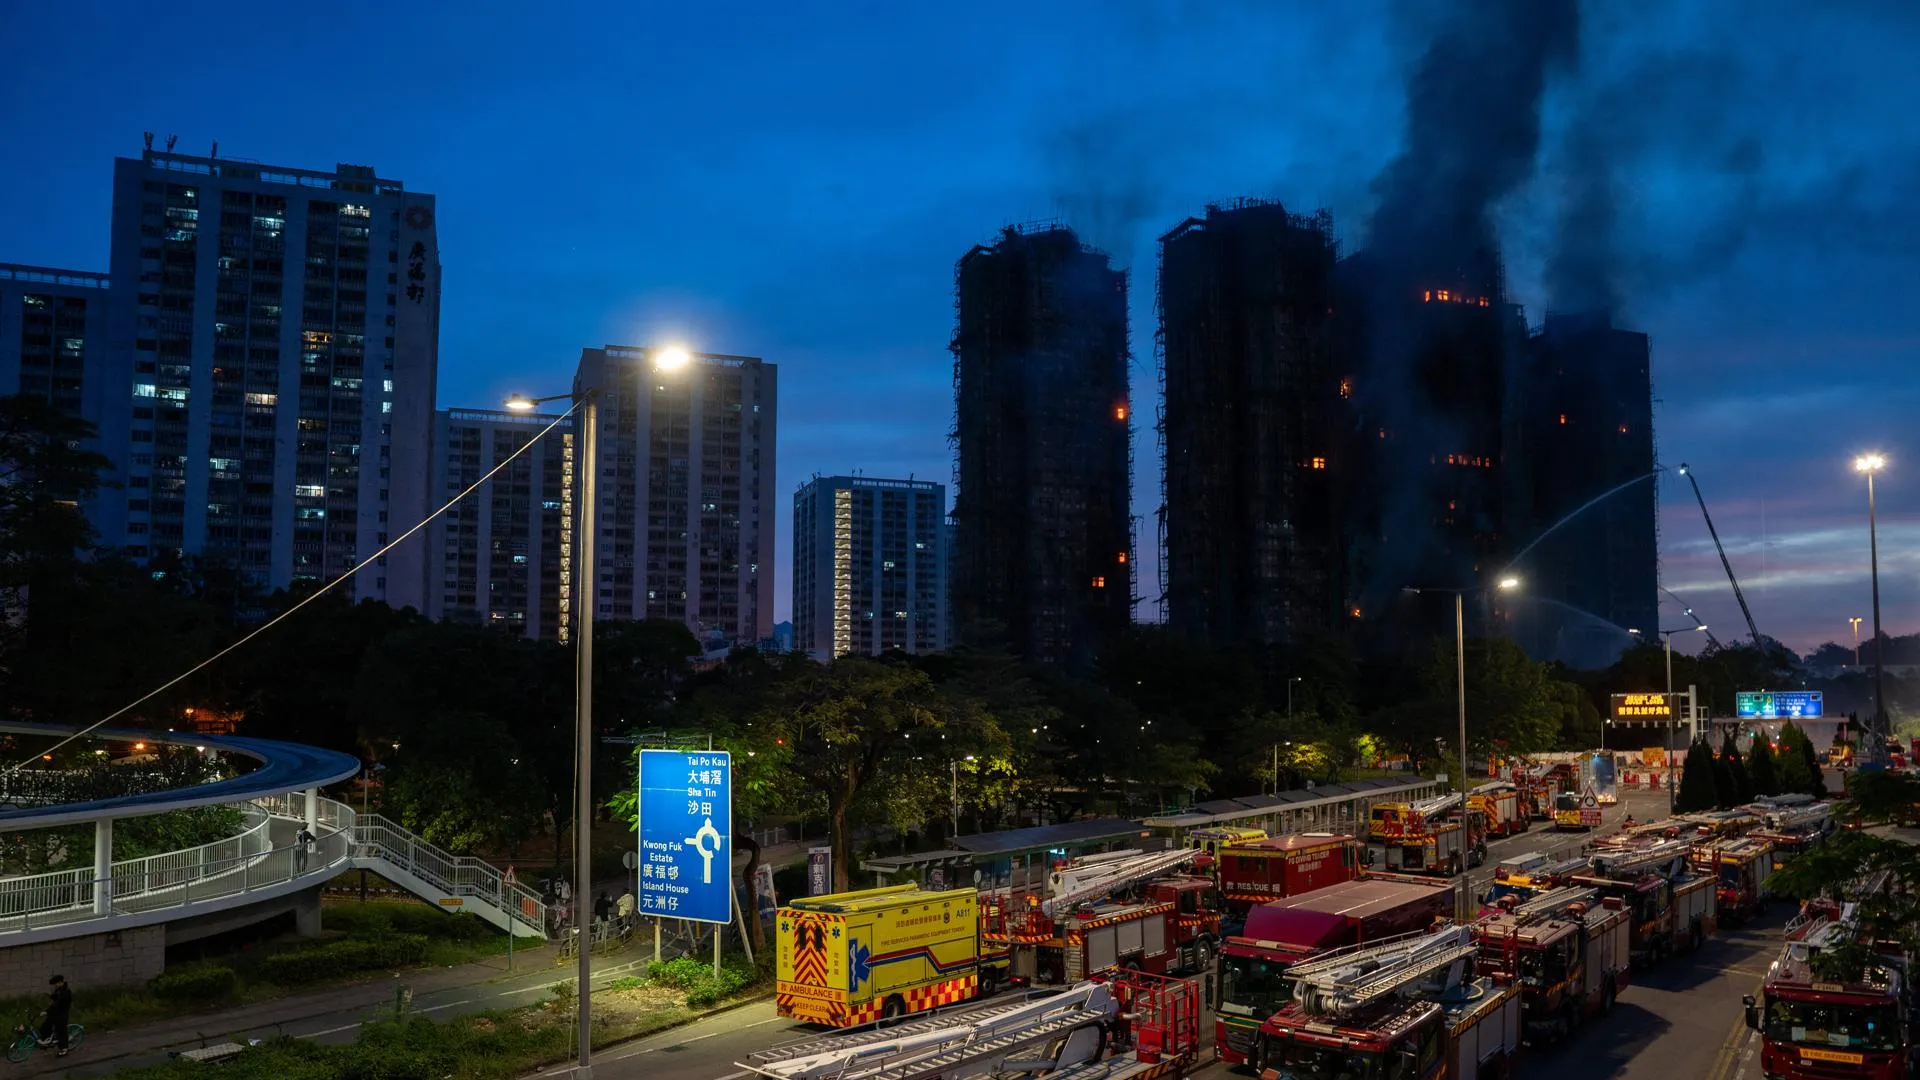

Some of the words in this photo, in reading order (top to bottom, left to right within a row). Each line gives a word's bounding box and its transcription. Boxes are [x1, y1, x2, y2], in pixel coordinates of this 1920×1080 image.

[687, 756, 699, 766] Tai
[700, 757, 710, 766] Po
[711, 757, 727, 767] Kau
[687, 769, 722, 785] 大埔滘
[687, 787, 702, 797] Sha
[704, 788, 717, 797] Tin
[687, 800, 712, 816] 沙田
[643, 840, 668, 852] Kwong
[669, 842, 683, 852] Fuk
[649, 852, 674, 863] Estate
[643, 863, 679, 880] 廣福邨
[642, 881, 664, 891] Island
[665, 883, 689, 894] House
[642, 894, 679, 911] 元洲仔
[789, 985, 833, 999] AMBULANCE
[796, 1002, 810, 1010] KEEP
[810, 1004, 826, 1012] CLEAR
